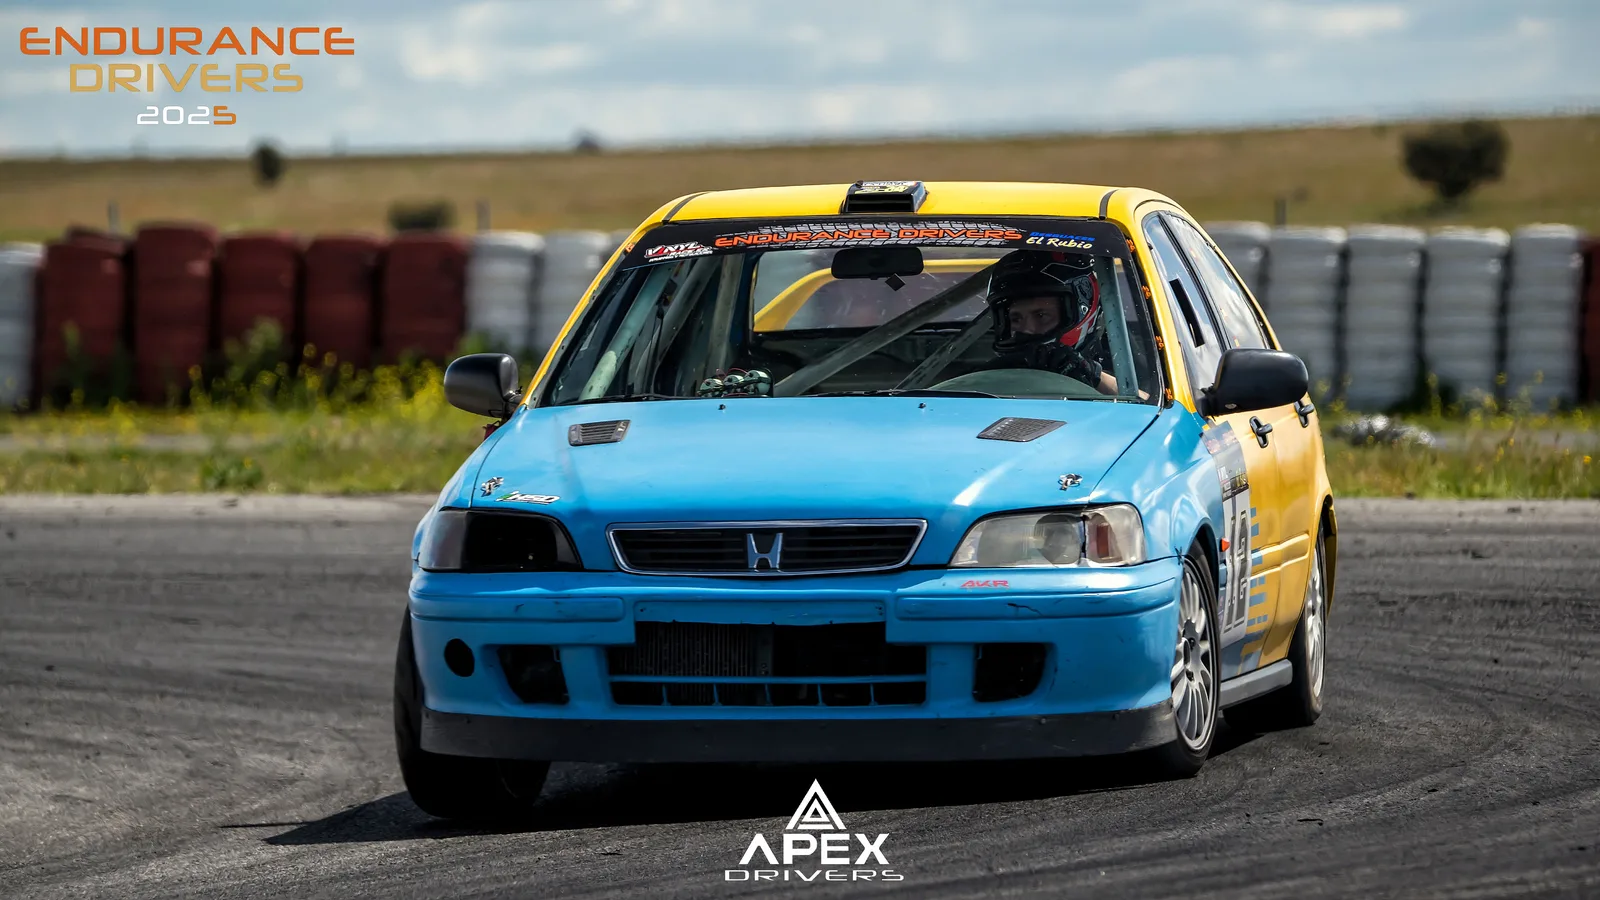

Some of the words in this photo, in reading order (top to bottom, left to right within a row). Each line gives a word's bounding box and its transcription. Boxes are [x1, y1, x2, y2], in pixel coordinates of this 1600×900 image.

[715, 229, 891, 247] ENDURANCE
[898, 229, 1023, 241] DRIVERS
[1026, 236, 1045, 245] El
[1046, 237, 1093, 249] Rubio
